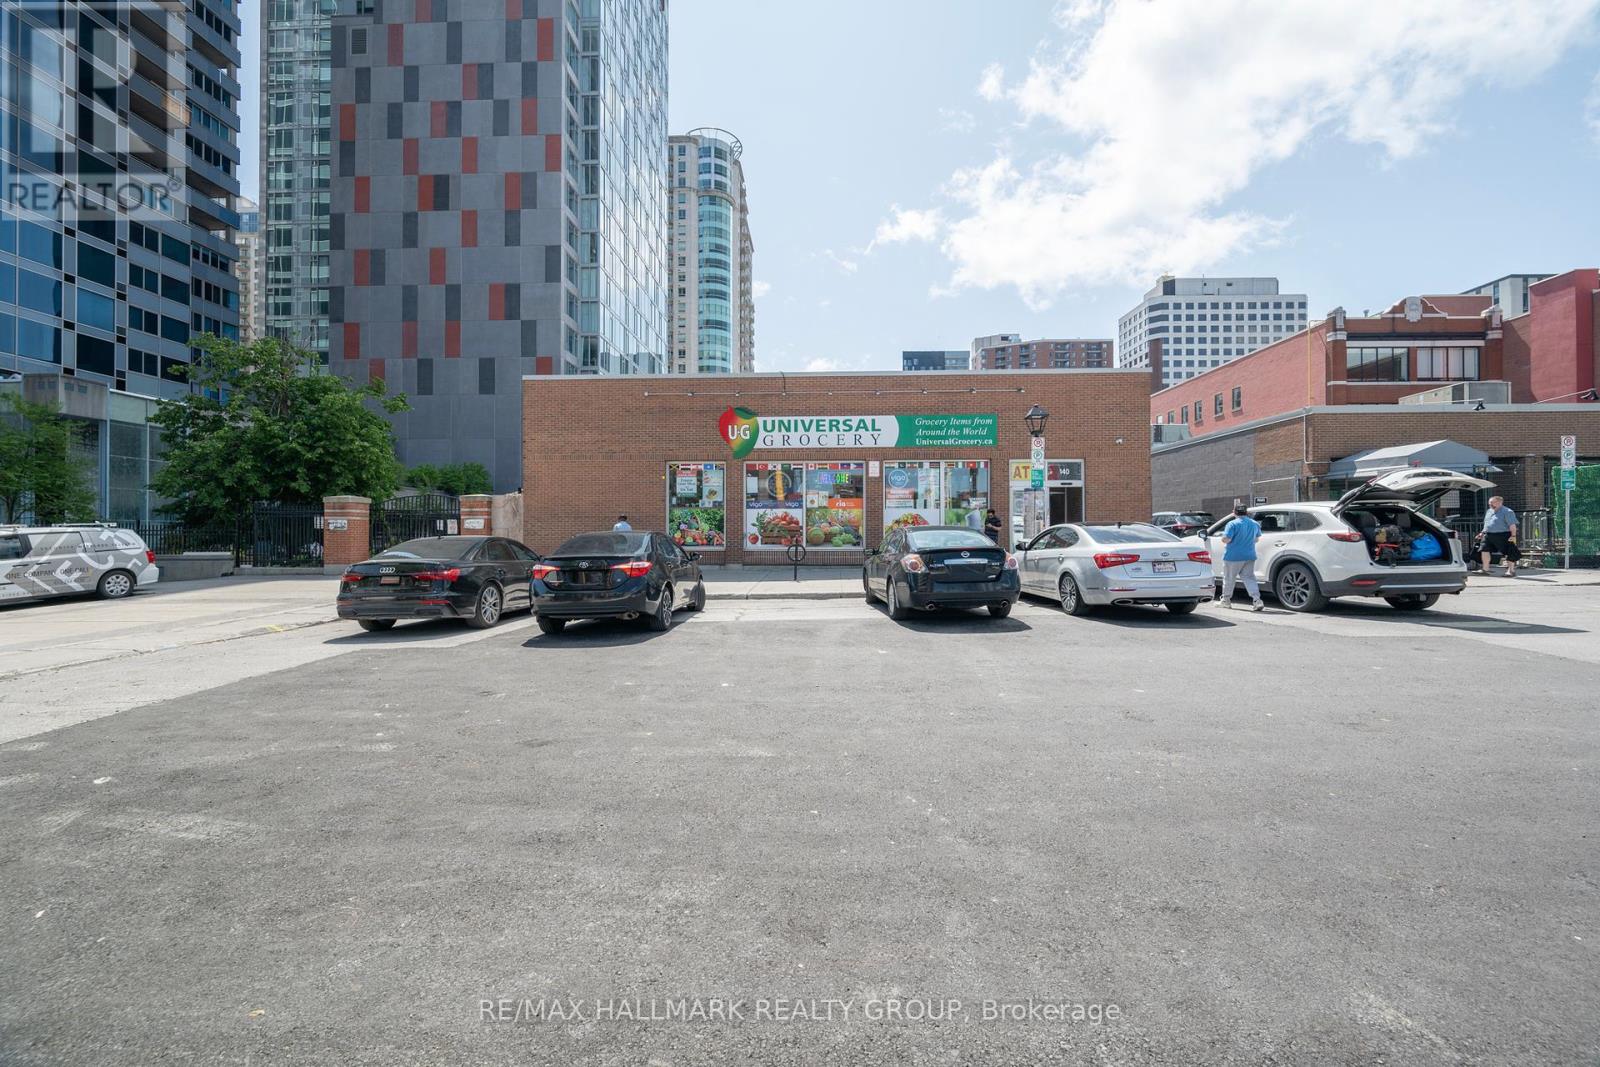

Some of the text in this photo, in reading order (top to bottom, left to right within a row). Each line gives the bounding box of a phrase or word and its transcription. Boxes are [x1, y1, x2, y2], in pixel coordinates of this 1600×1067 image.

[762, 418, 882, 433] UNIVERSAL
[915, 417, 993, 427] Grocery Items from
[915, 427, 988, 436] Around the World
[762, 434, 882, 447] GROCERY
[915, 438, 993, 447] UniversalGrocery.ca
[1012, 465, 1030, 479] AT
